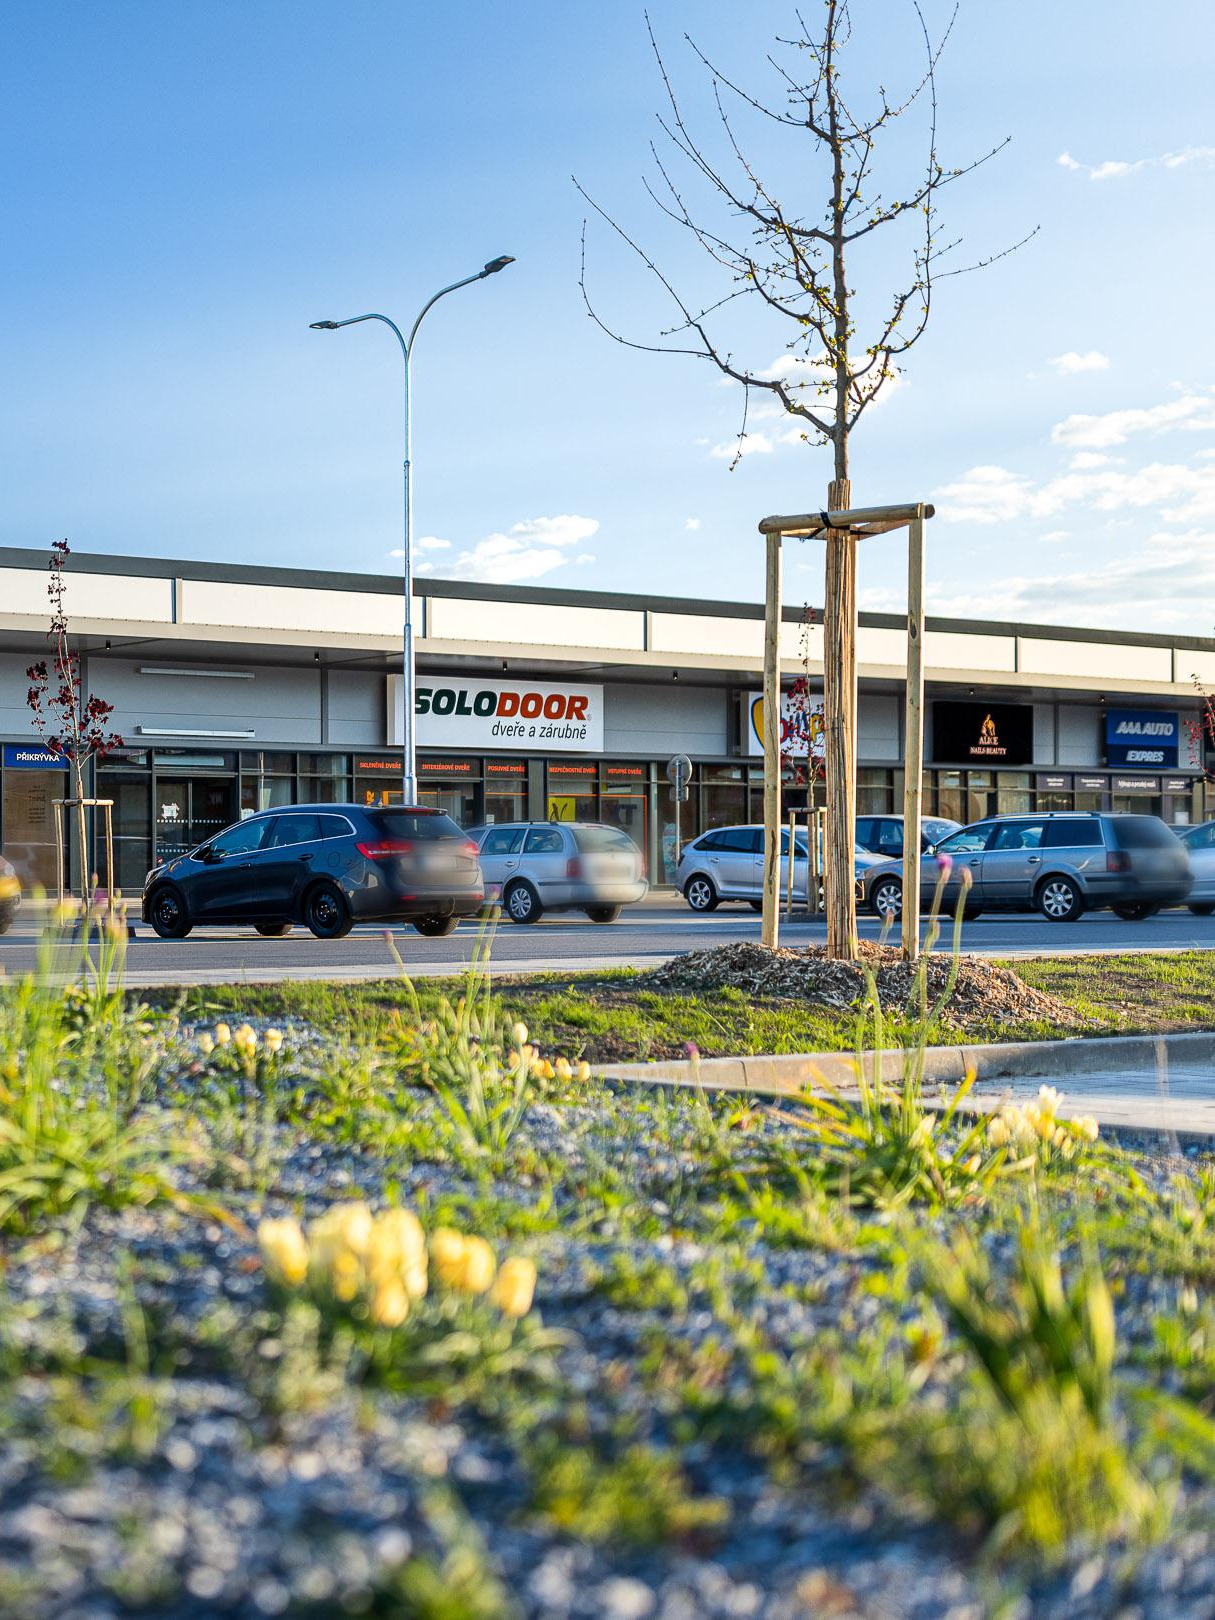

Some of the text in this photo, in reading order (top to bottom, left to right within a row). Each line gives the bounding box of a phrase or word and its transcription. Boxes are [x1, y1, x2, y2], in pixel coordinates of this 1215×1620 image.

[415, 688, 589, 721] SOLODOOR
[492, 721, 587, 740] dveře a zárubně
[1116, 721, 1174, 736] AAA AUTO
[1126, 750, 1165, 762] EXPRES
